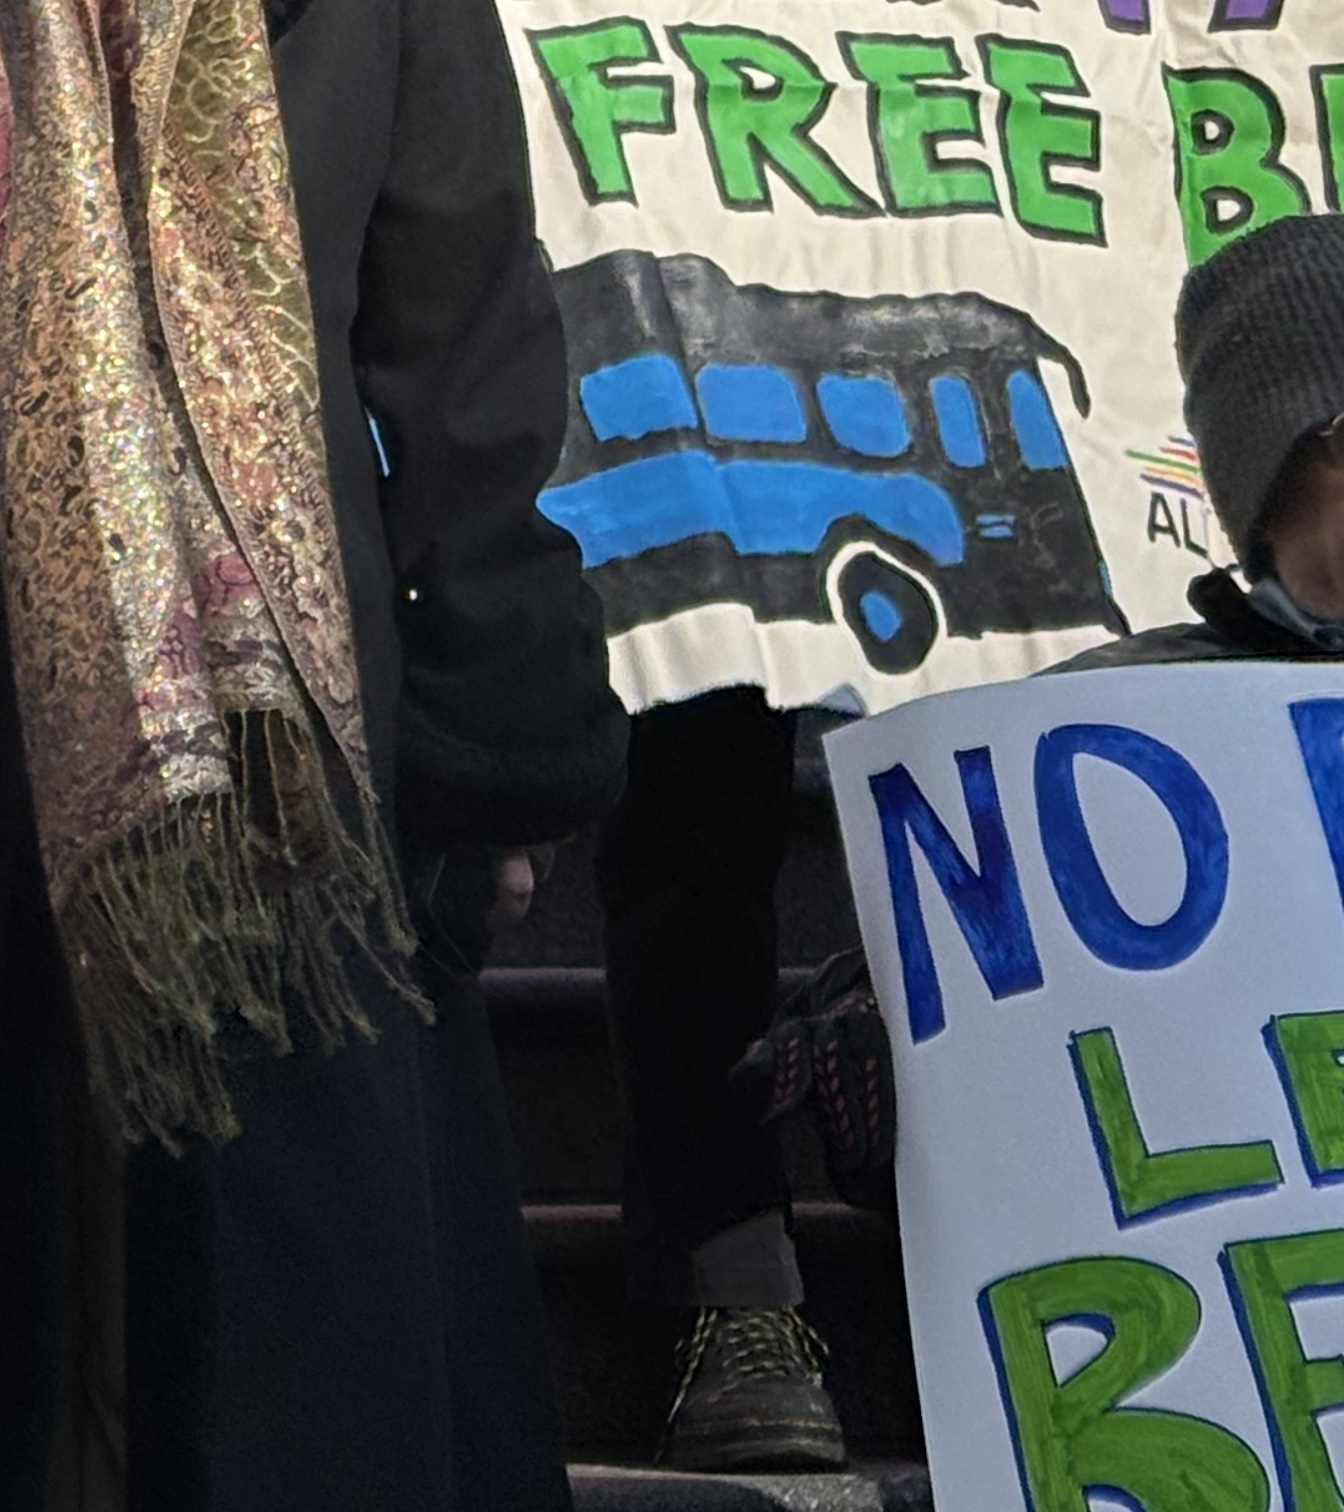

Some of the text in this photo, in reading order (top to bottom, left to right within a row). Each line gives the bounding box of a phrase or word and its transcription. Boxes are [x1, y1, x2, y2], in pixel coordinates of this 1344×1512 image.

[526, 16, 1344, 270] FREE B
[869, 722, 1230, 1046] NO
